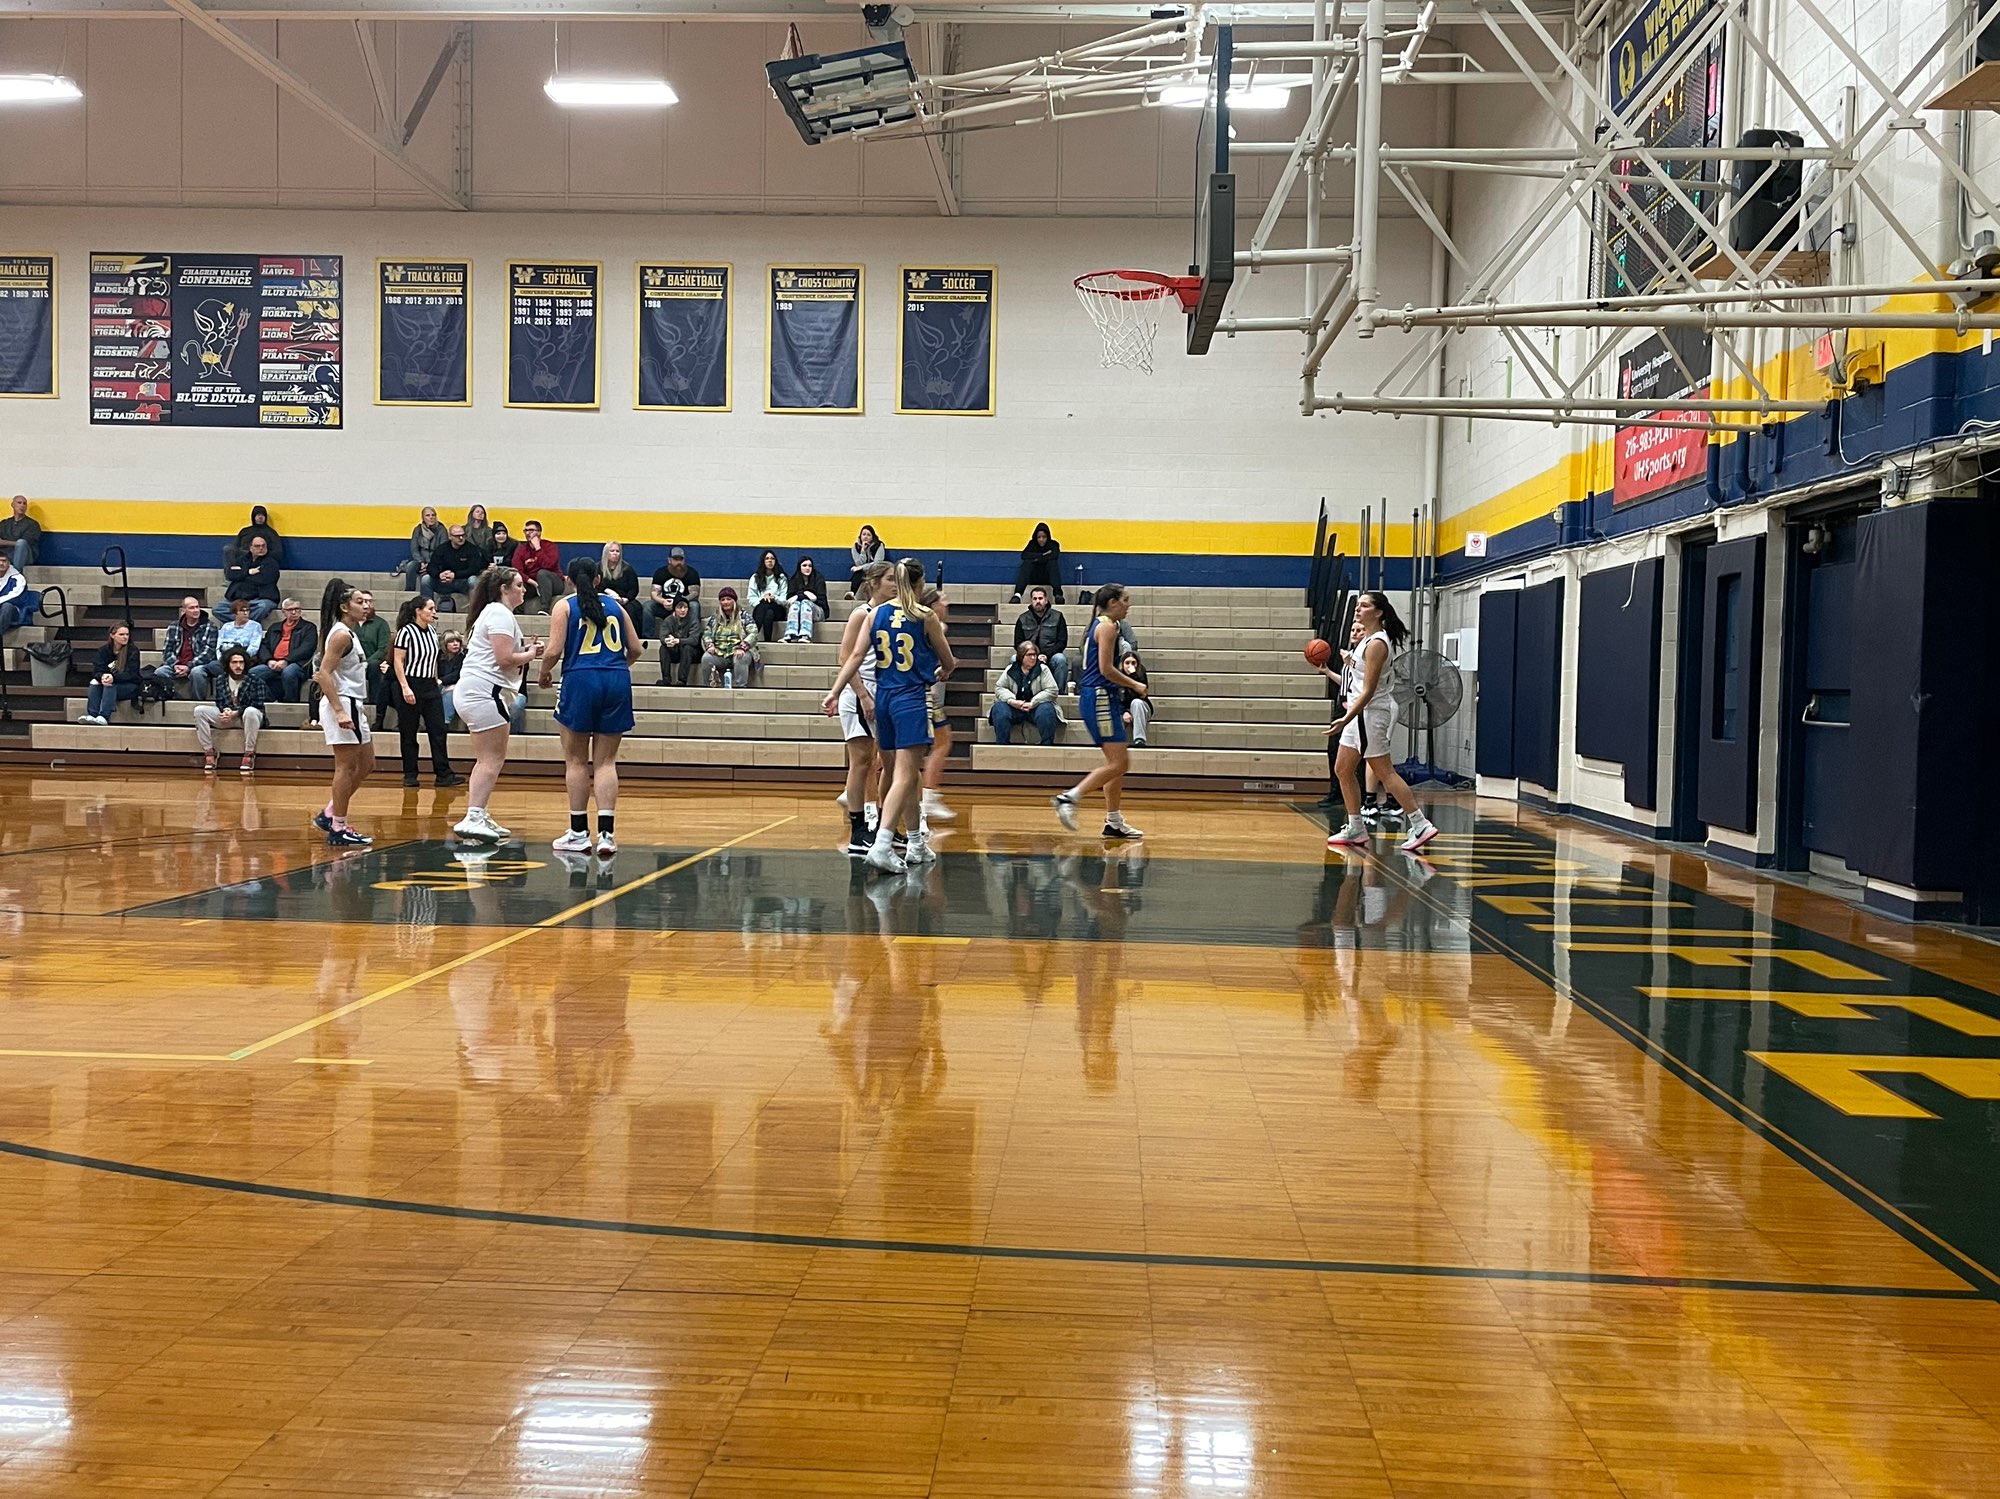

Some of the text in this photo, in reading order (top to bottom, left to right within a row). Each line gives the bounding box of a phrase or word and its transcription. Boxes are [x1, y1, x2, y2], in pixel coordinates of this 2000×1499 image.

[0, 265, 48, 275] RACK & FIELD
[179, 276, 252, 285] CONFERENCE
[407, 272, 463, 282] TRACK & FIELD
[543, 273, 586, 285] SOFTBALL
[667, 275, 723, 286] BASKETBALL
[798, 278, 856, 288] CROSS COUNTRY
[942, 278, 976, 289] SOCCER
[32, 290, 49, 298] 2015
[446, 297, 463, 305] 2019
[514, 298, 531, 306] 1983
[514, 307, 530, 315] 1991
[907, 303, 925, 311] 2015
[261, 310, 304, 318] HORNETS
[514, 317, 531, 325] 2014
[534, 317, 551, 325] 2015
[93, 370, 136, 378] SKIPPERS
[175, 393, 209, 402] BLUE
[210, 393, 256, 403] DEVILS
[579, 615, 623, 655] 20
[875, 629, 915, 672] 33
